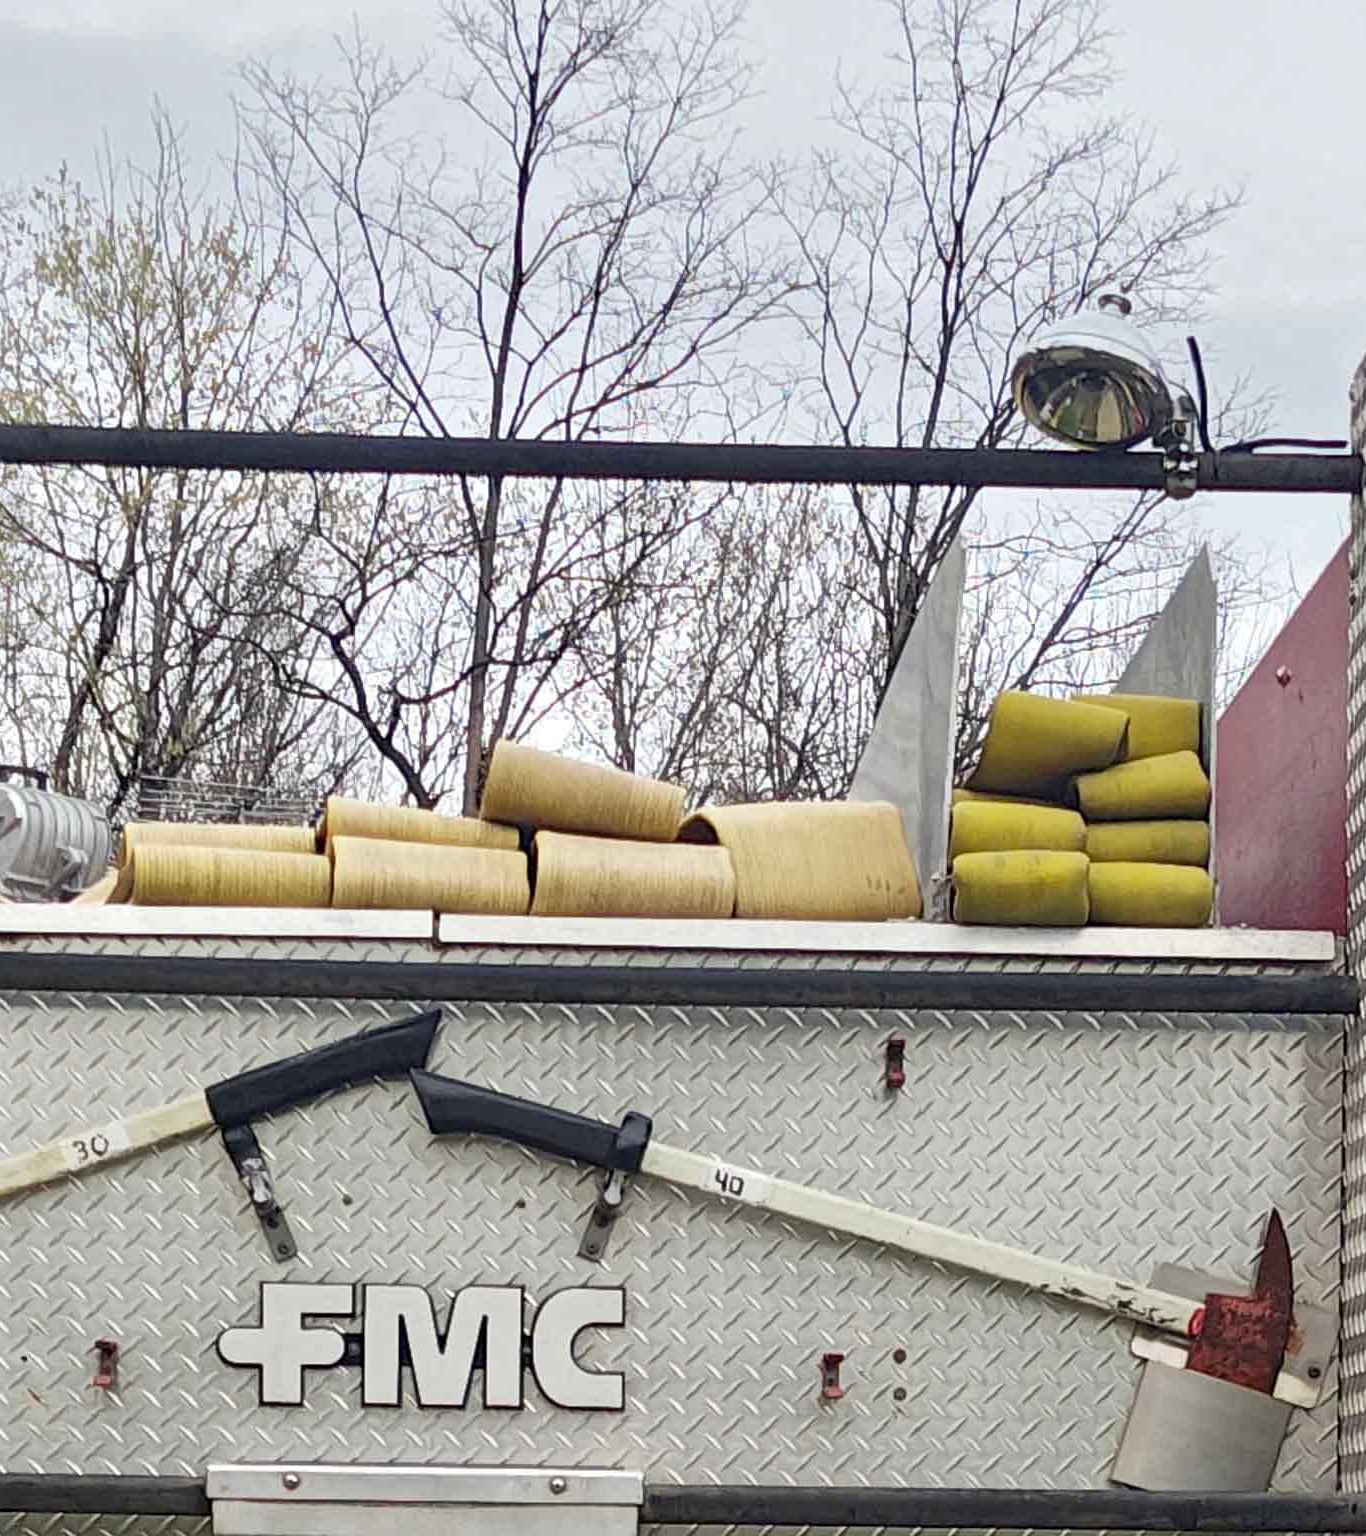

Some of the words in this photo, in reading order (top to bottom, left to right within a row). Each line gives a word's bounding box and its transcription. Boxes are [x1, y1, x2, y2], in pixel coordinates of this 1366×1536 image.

[72, 1133, 110, 1164] 30
[715, 1168, 745, 1196] 40
[216, 1283, 625, 1410] FMC
